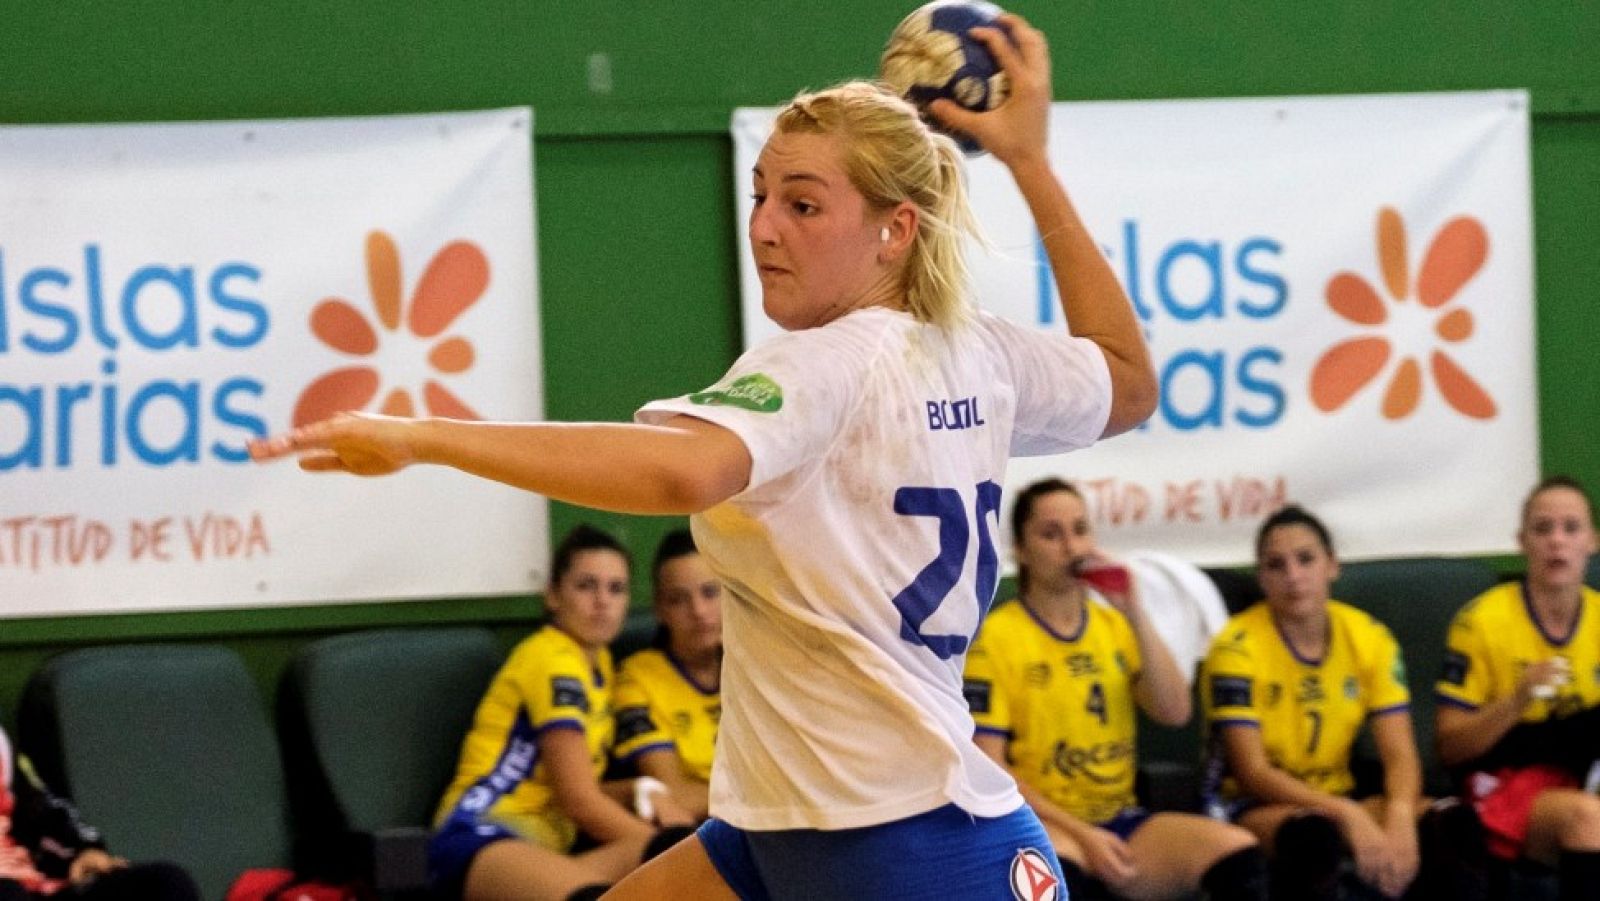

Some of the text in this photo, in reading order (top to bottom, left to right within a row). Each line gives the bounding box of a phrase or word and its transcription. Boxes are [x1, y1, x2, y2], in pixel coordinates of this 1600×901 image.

[1034, 219, 1289, 326] Ilas
[0, 509, 270, 571] TITUD DE VIDA
[1086, 683, 1108, 725] 4
[1305, 710, 1322, 754] 7
